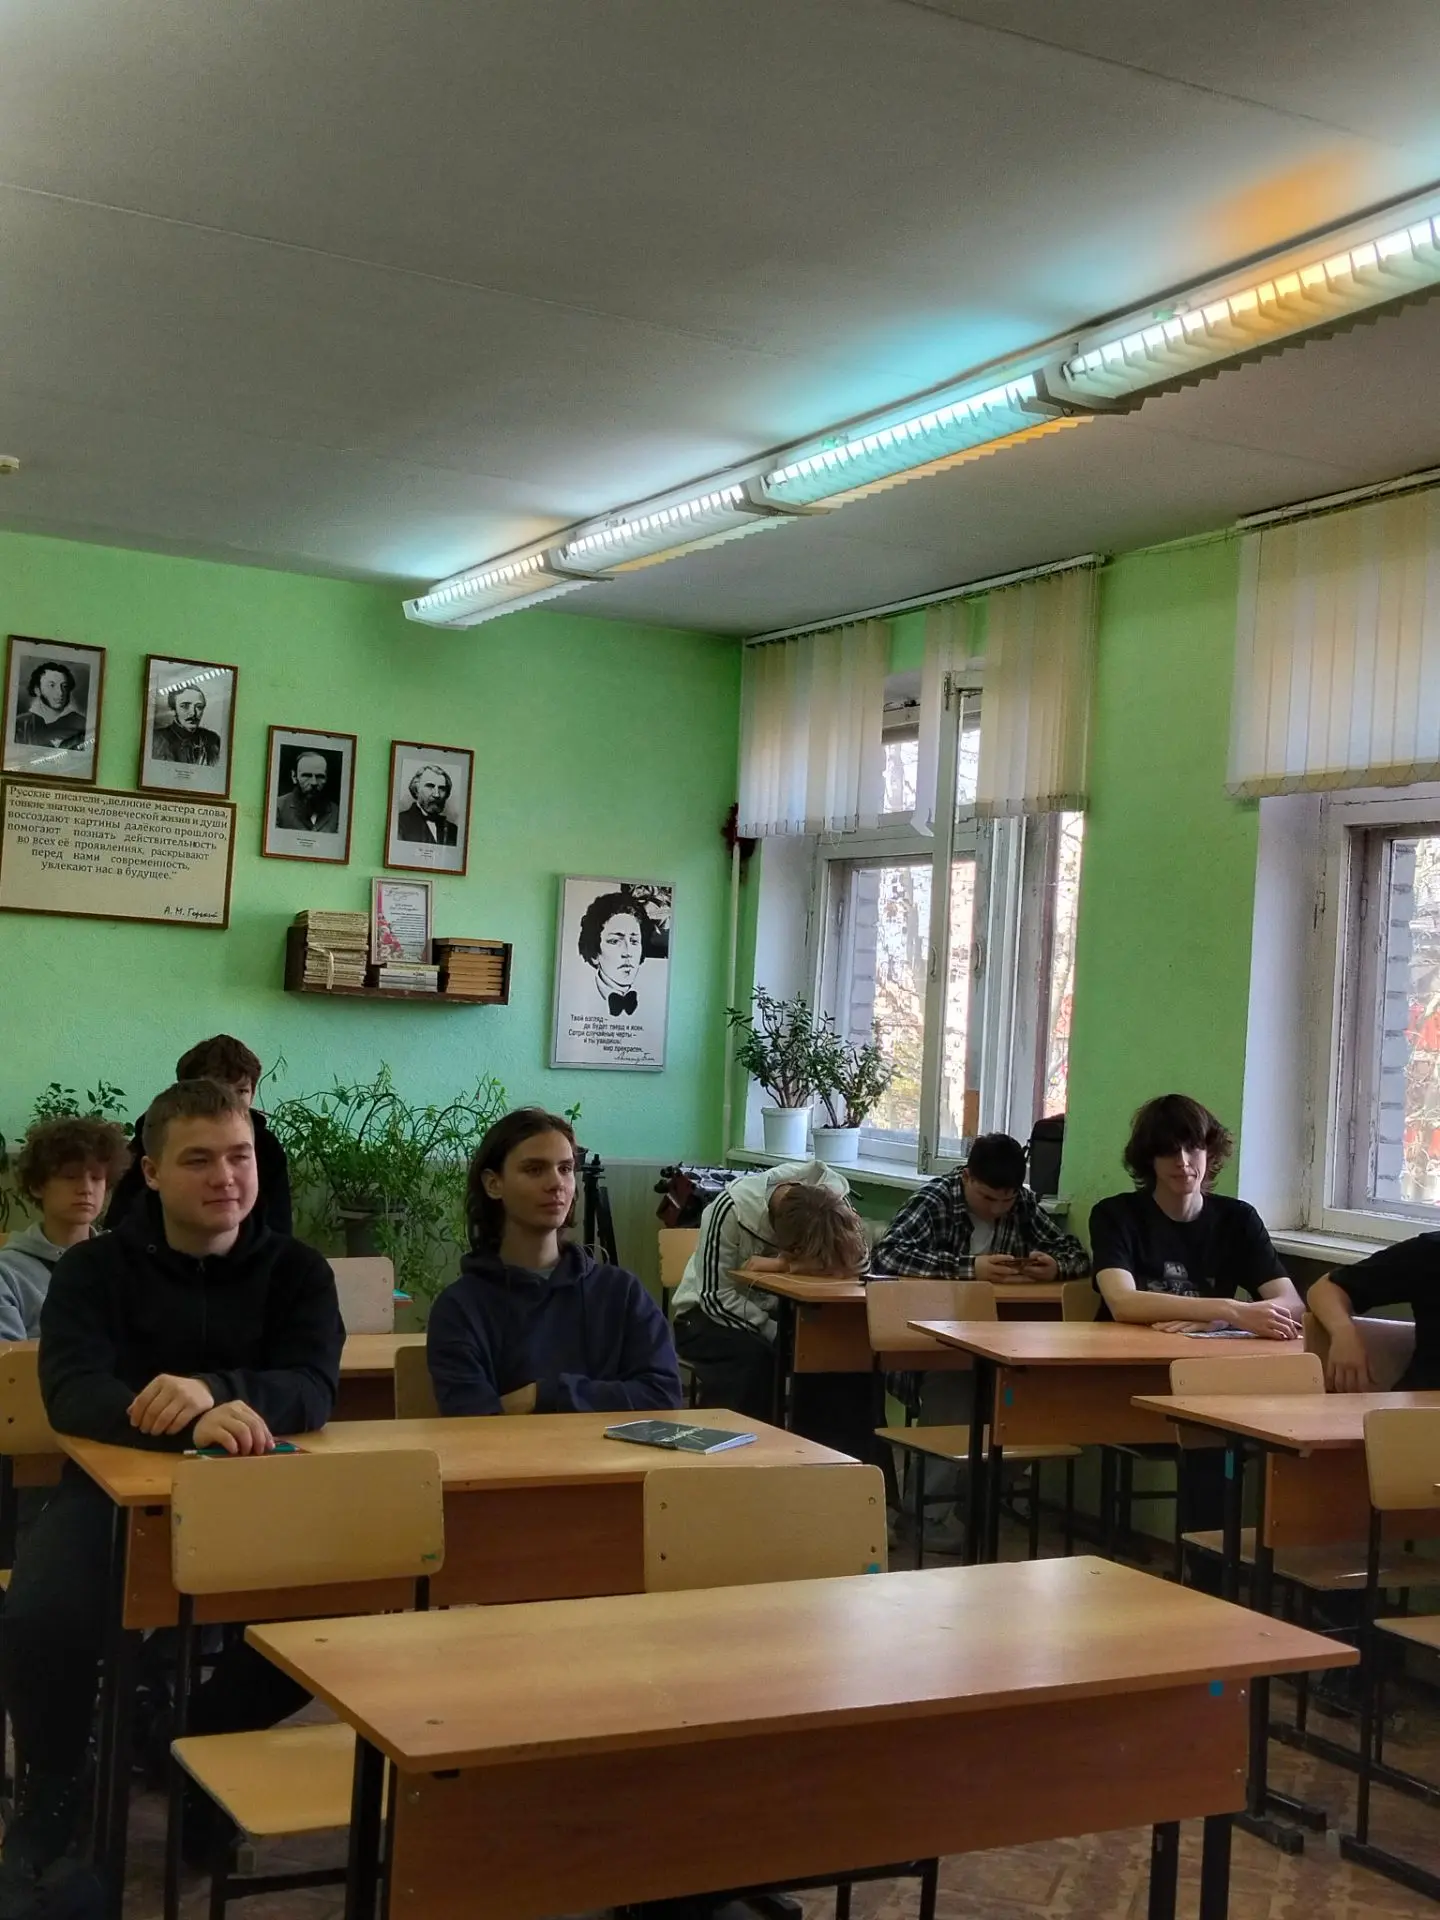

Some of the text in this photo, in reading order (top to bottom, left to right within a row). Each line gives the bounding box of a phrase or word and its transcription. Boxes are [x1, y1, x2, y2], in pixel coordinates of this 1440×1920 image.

[10, 786, 50, 798] Русские
[154, 804, 196, 815] мастера
[198, 808, 228, 818] слова,
[8, 810, 228, 840] воссоздают картины далёкого прошлого,
[10, 800, 46, 809] тонкие
[46, 802, 85, 813] знатоки
[88, 807, 158, 821] человеческой
[160, 816, 191, 825] жизни
[200, 818, 228, 829] души
[7, 822, 217, 850] помогают познать действительность
[17, 836, 210, 860] во всех её проявлениях, раскрывают
[32, 848, 190, 870] перед нами современность,
[41, 860, 93, 873] увлекают
[96, 866, 112, 874] нас
[117, 868, 123, 876] в
[164, 906, 172, 914] А.
[175, 906, 184, 916] М.
[568, 1029, 584, 1037] Сотри
[592, 1022, 608, 1030] будет
